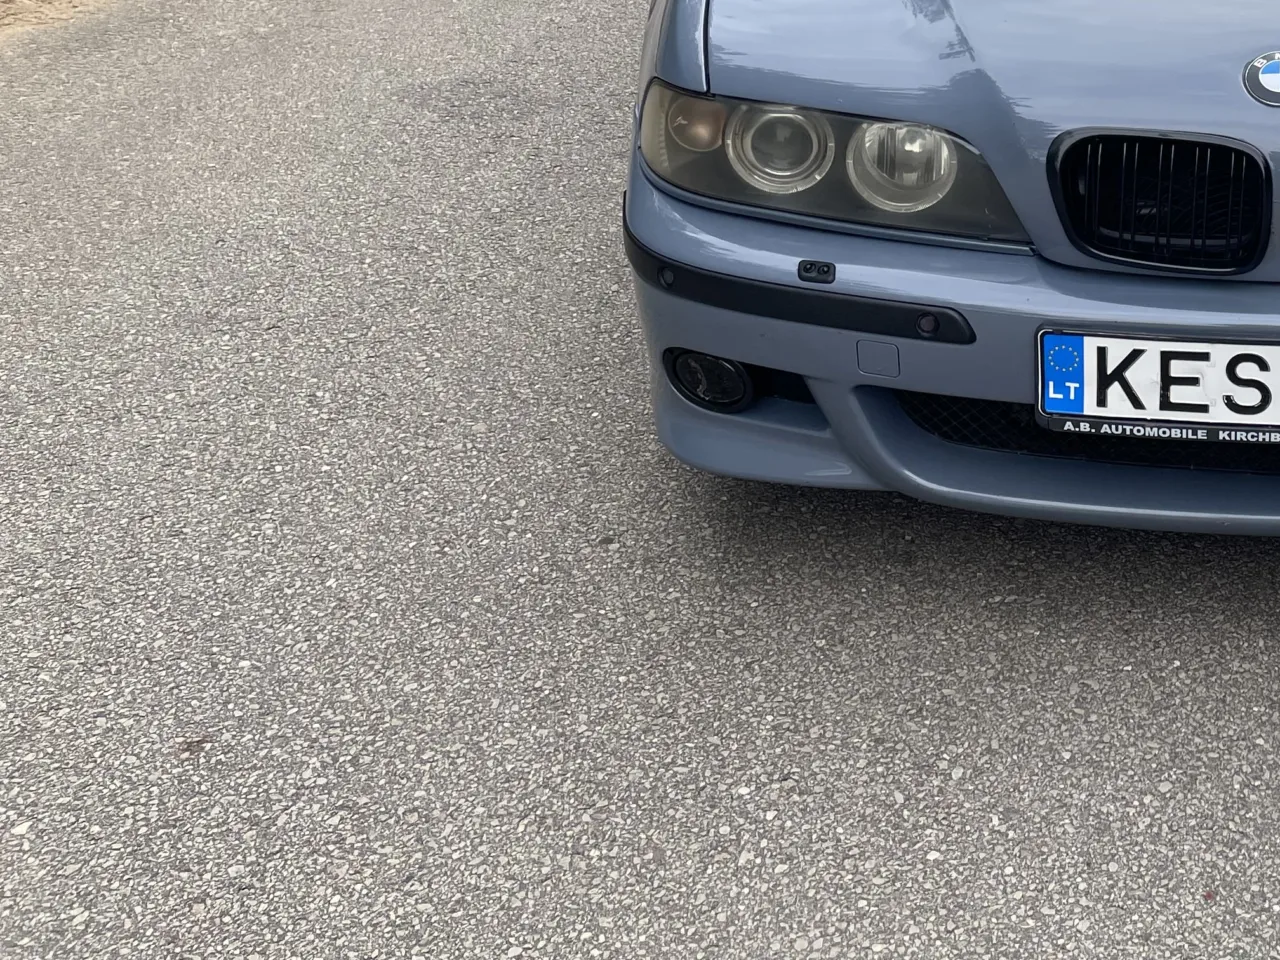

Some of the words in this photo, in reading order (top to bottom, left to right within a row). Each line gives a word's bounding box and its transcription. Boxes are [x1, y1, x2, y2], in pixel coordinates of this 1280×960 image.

[1096, 345, 1272, 416] KES
[1048, 381, 1080, 400] LT
[1063, 421, 1096, 433] A.B.
[1100, 423, 1208, 440] AUTOMOBILE
